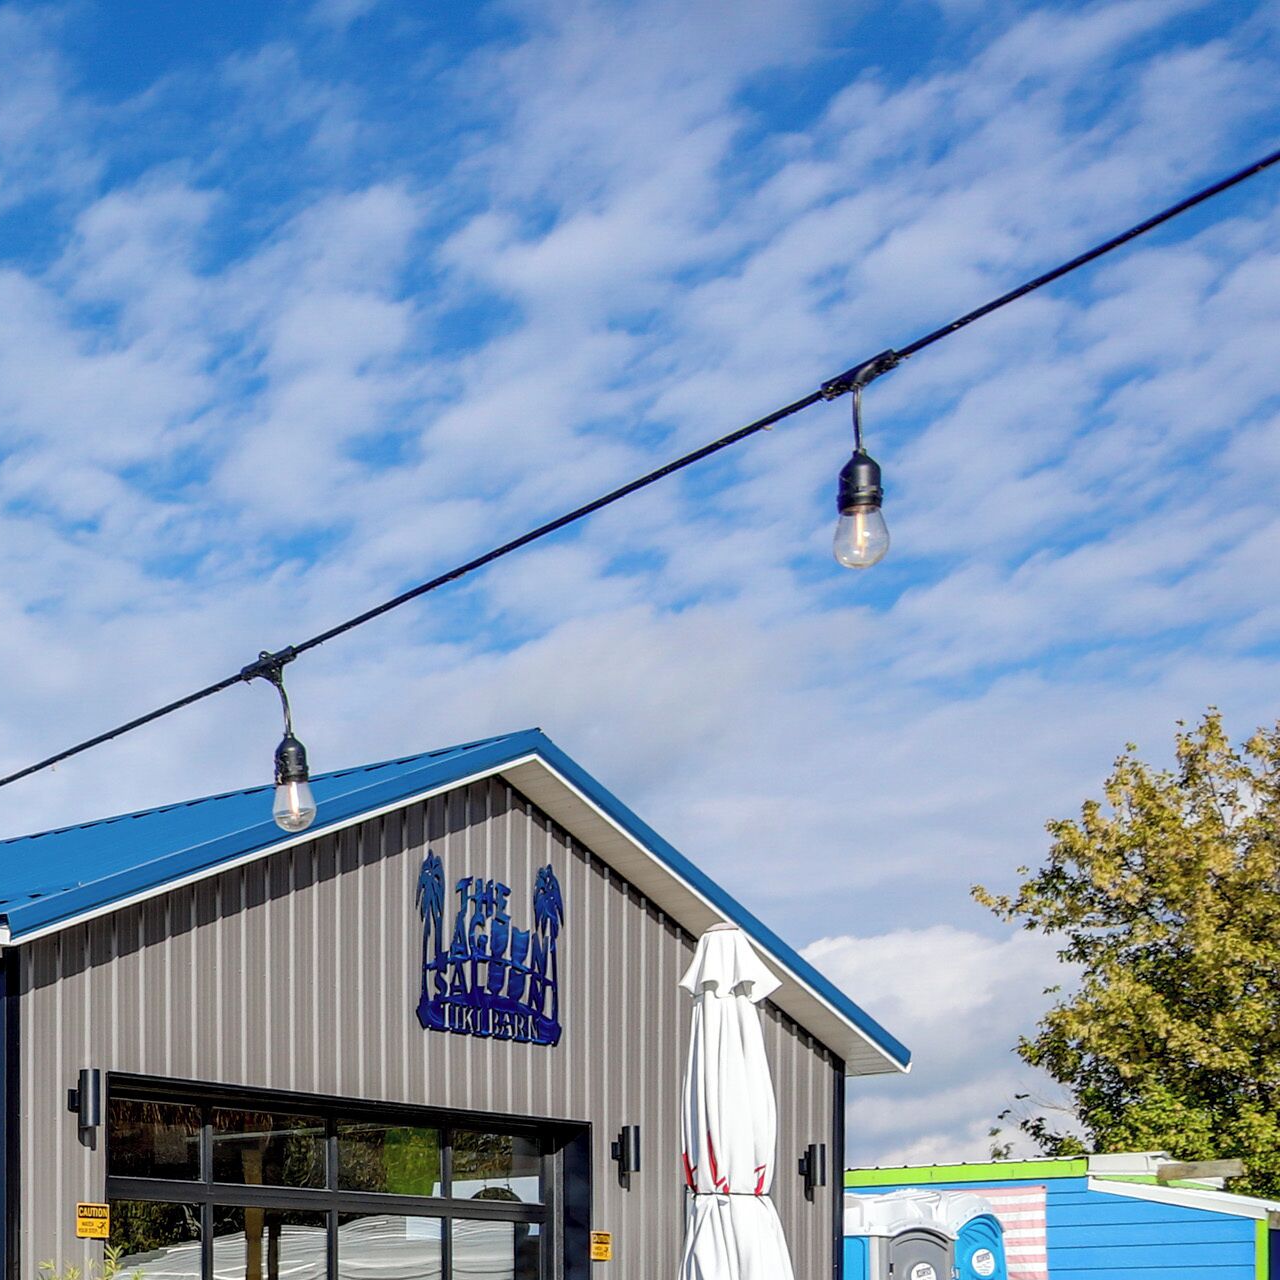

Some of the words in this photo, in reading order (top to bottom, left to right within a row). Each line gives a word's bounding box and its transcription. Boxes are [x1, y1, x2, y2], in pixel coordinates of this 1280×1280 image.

[455, 876, 511, 924] THE
[441, 1002, 481, 1033] TIKI
[487, 1008, 538, 1040] BARN
[78, 1207, 108, 1217] CAUTION
